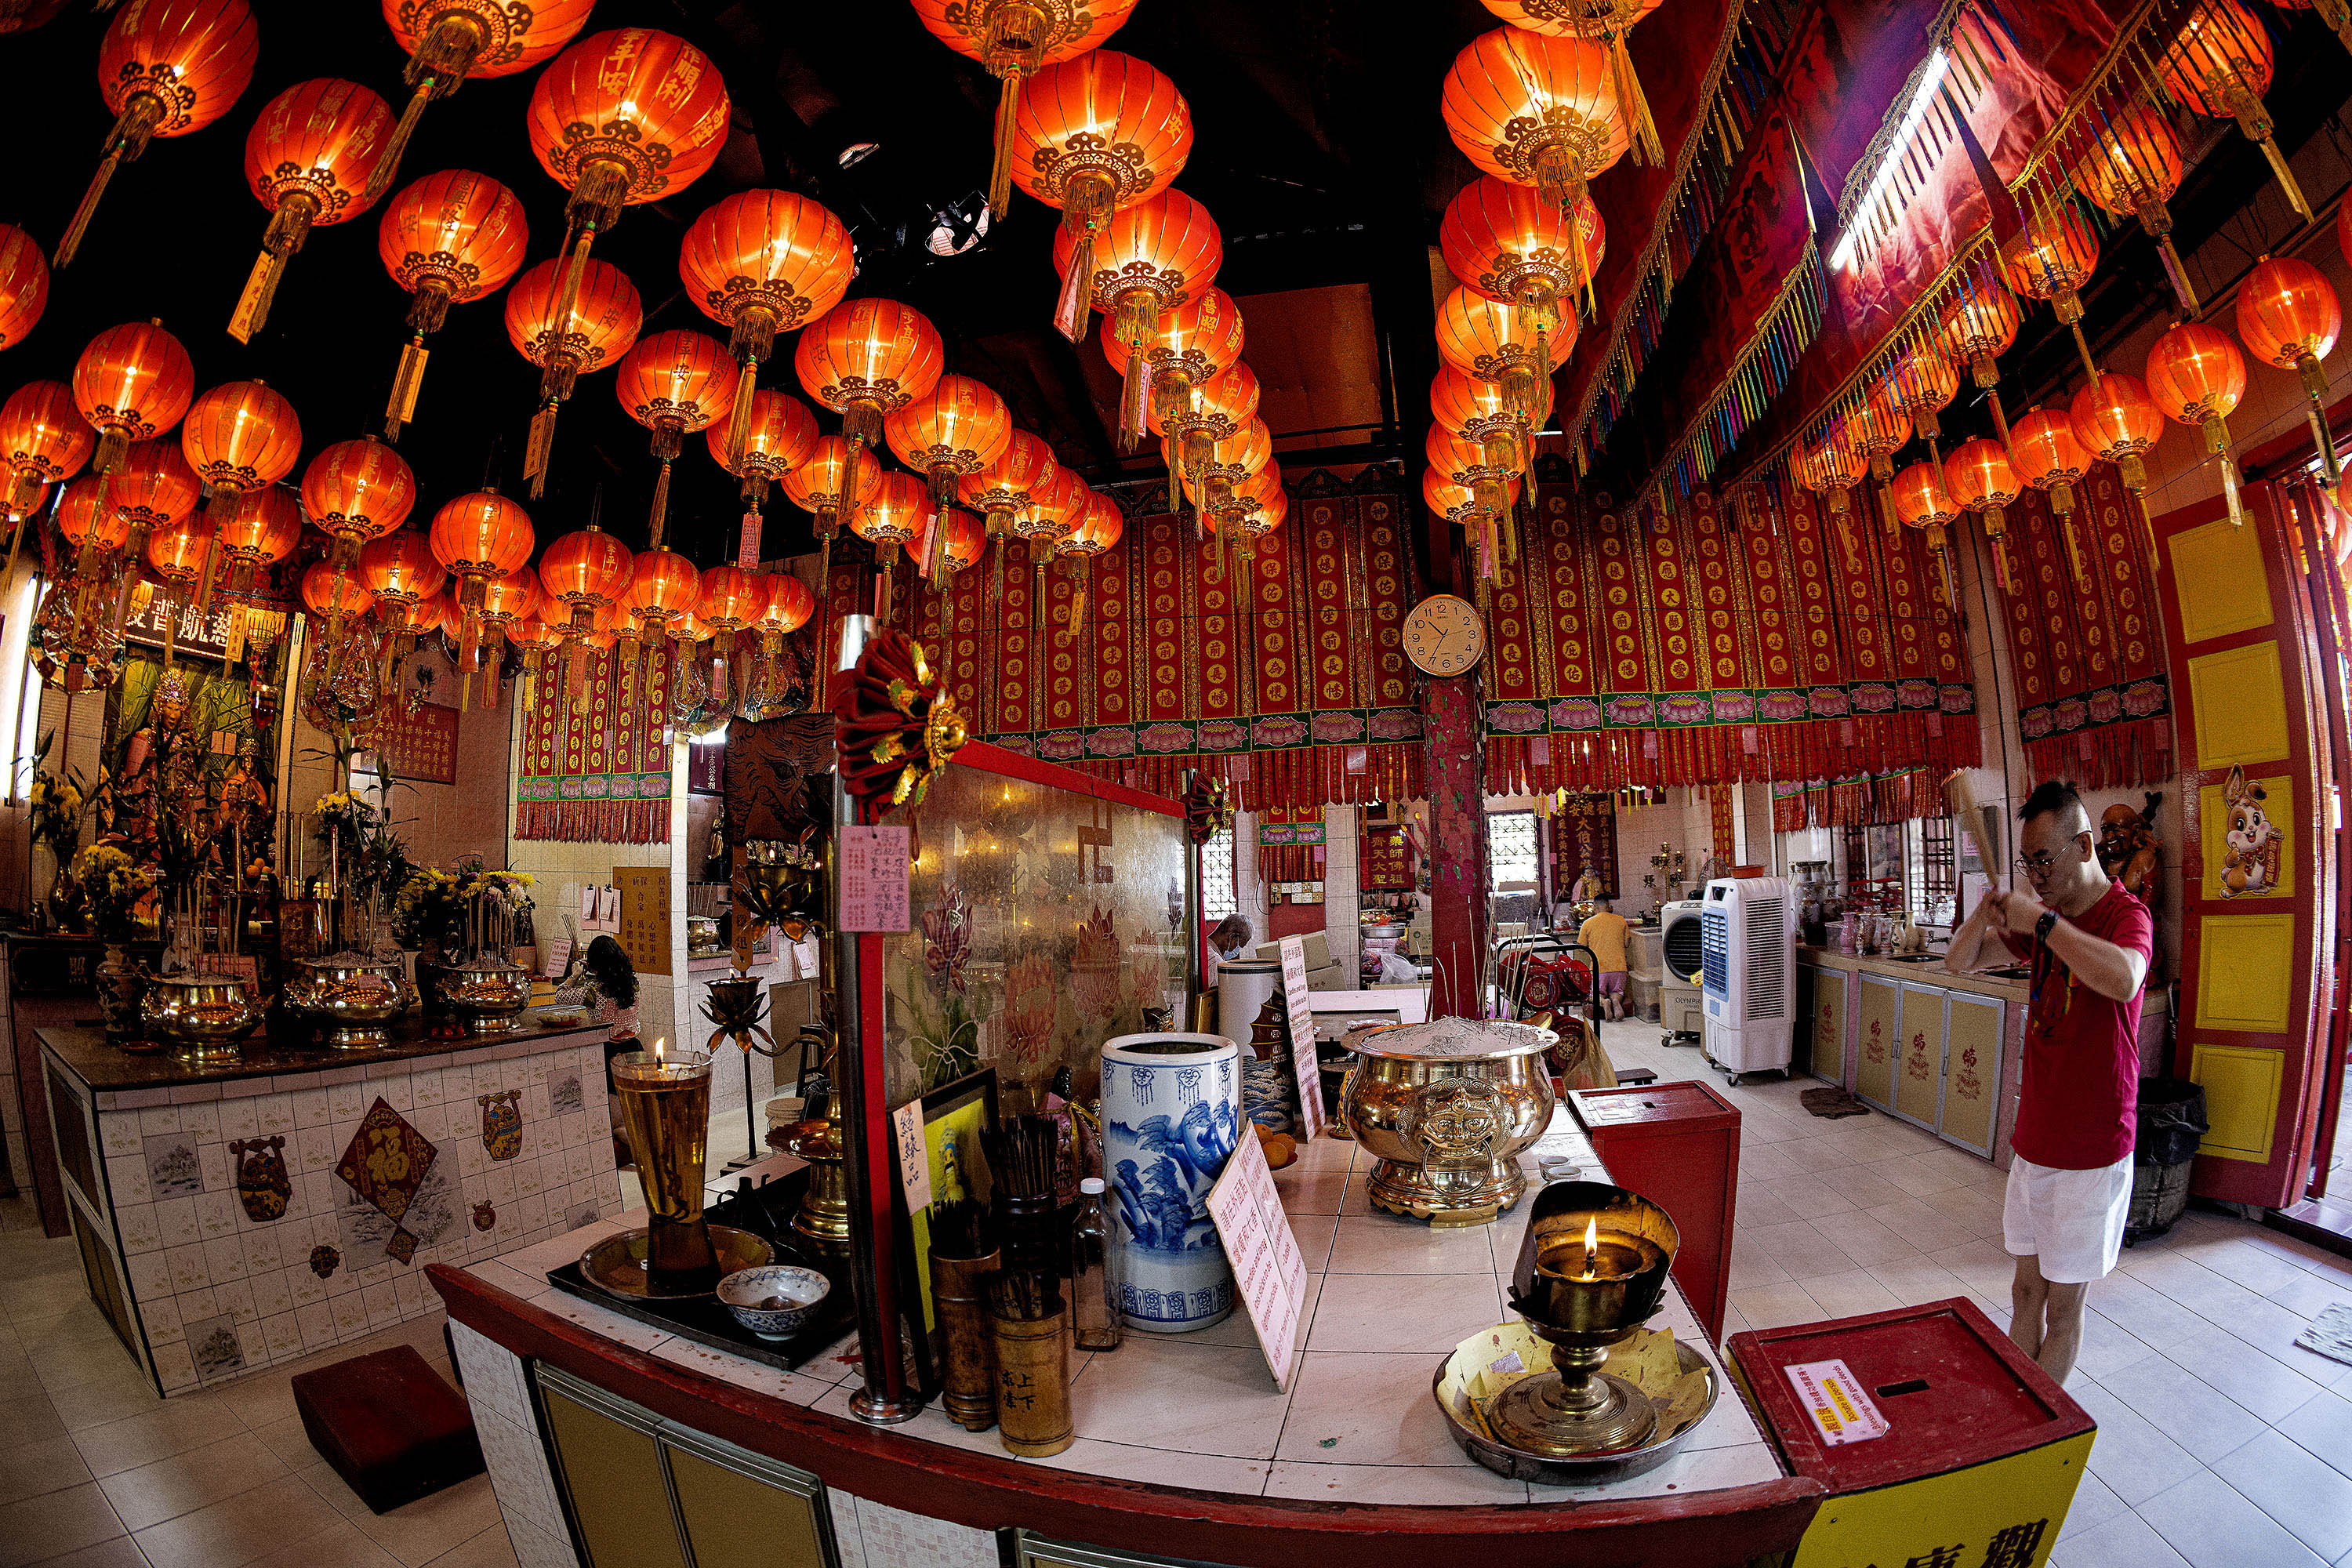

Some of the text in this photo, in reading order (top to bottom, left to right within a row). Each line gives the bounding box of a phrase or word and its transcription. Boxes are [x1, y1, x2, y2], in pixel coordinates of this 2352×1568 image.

[1314, 507, 1342, 699] 觀音娘娘座前長幡
[1436, 604, 1446, 613] 12
[1153, 524, 1174, 706] 觀音娘娘座前長幡
[1425, 608, 1432, 617] 11
[1414, 620, 1425, 629] 10
[1463, 616, 1470, 626] 2
[1412, 633, 1420, 642] 9
[1468, 630, 1475, 639] 3
[1417, 647, 1425, 655] 8
[1443, 659, 1450, 668] 6
[1457, 655, 1464, 663] 5
[1372, 836, 1388, 884] 齊天大聖
[1389, 835, 1405, 884] 藥師佛祖
[366, 1126, 410, 1185] 福
[1219, 1176, 1248, 1232] 請在外面點
[1243, 1262, 1256, 1293] Candles
[1840, 1379, 1858, 1393] good
[1849, 1392, 1864, 1405] with
[1838, 1401, 1858, 1422] Donate
[1859, 1404, 1880, 1430] Blessings
